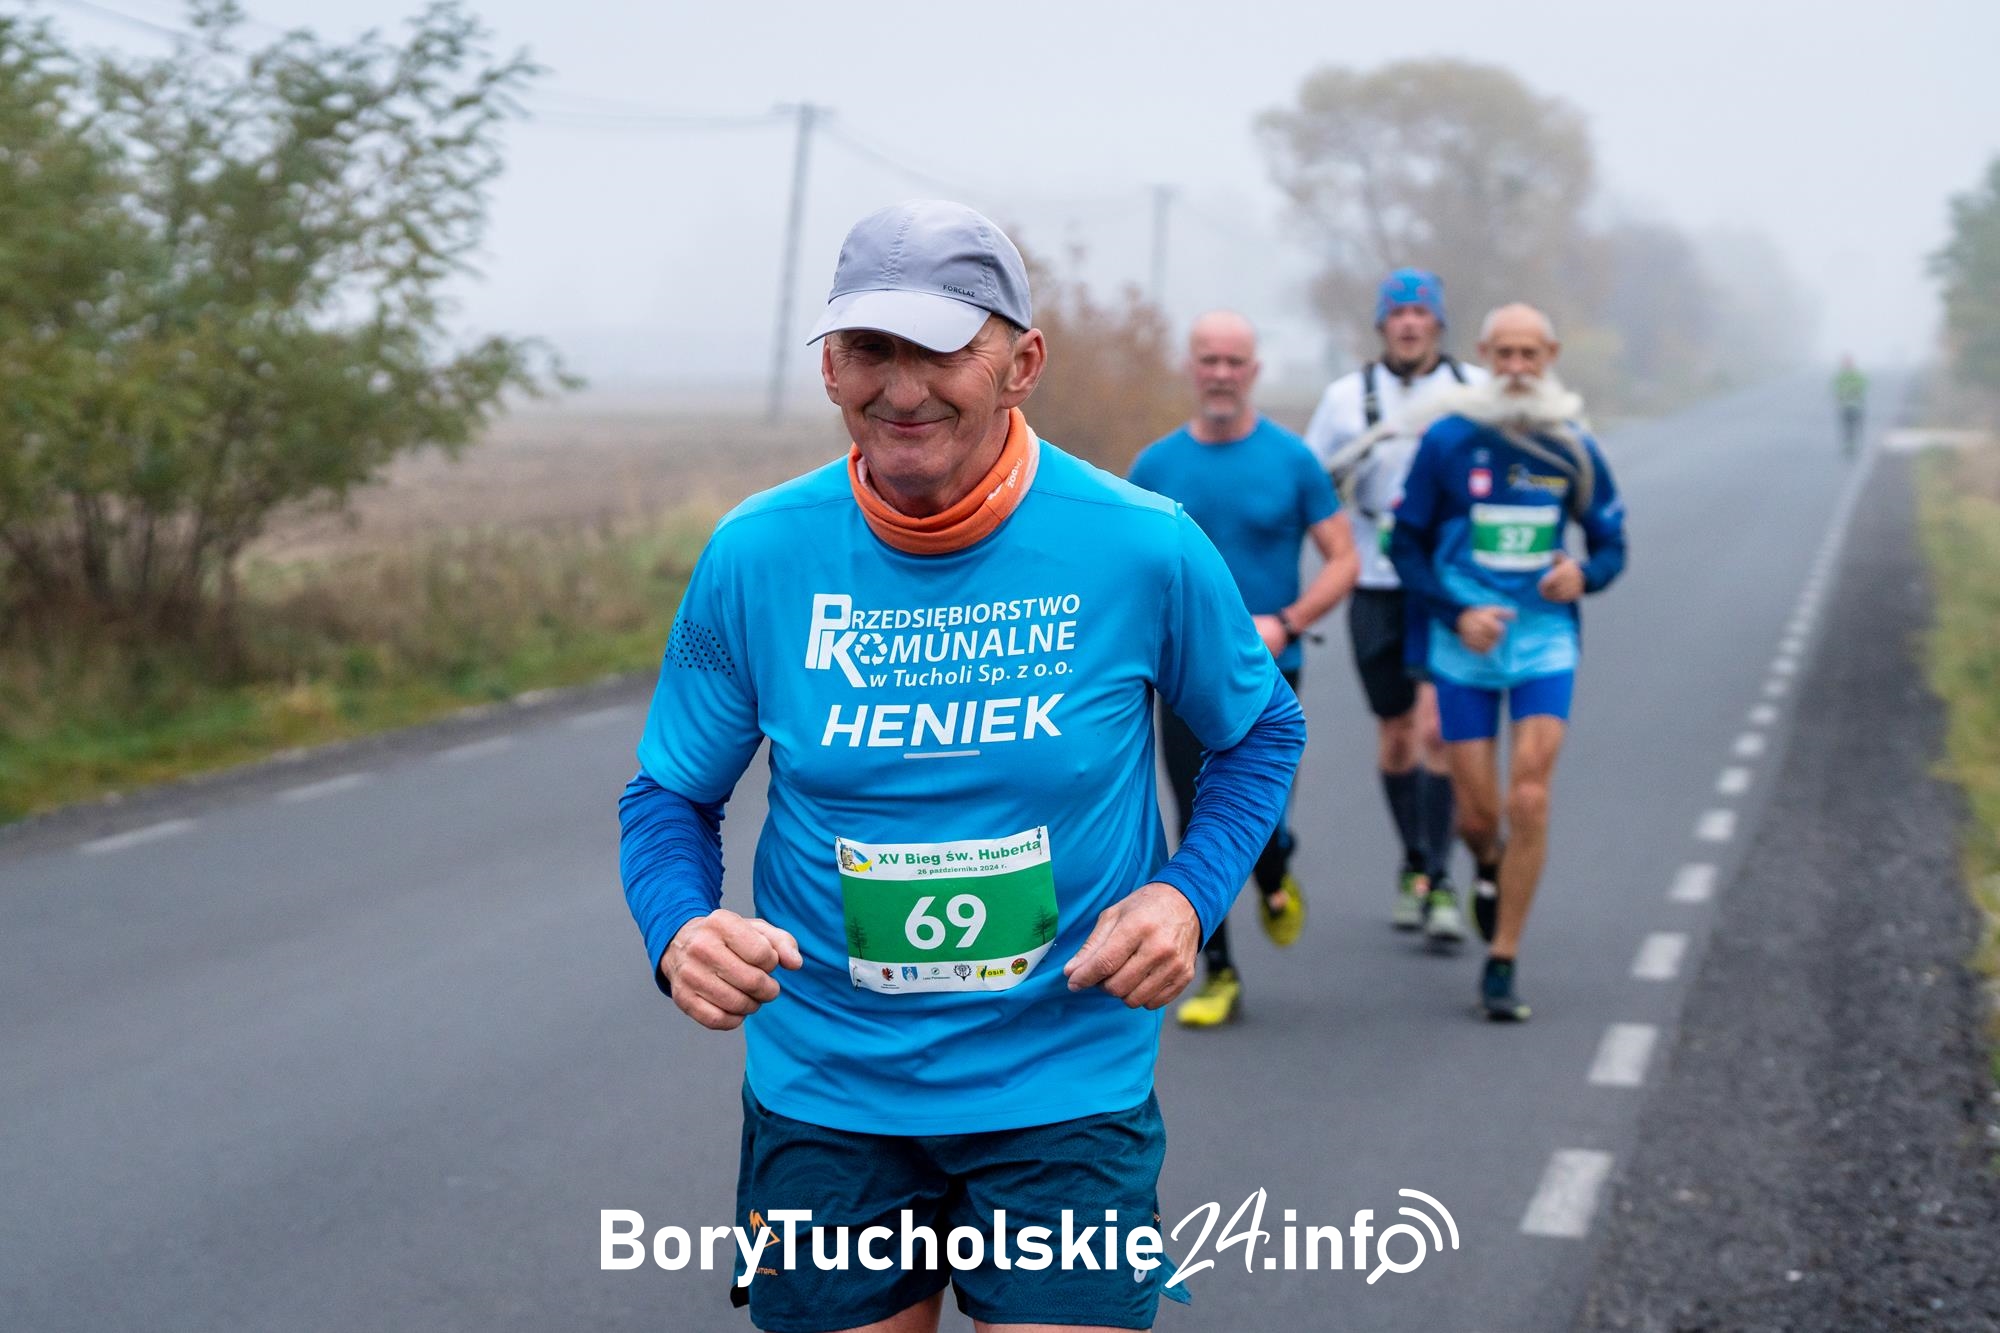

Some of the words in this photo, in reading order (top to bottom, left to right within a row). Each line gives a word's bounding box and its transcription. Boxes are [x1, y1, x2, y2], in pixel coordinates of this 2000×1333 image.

[943, 284, 975, 298] FORCLAZ
[869, 674, 887, 687] w
[893, 665, 973, 687] Tucholi
[978, 664, 1011, 686] Sp.
[1017, 665, 1028, 679] z
[1034, 661, 1073, 677] o.o.
[820, 693, 1065, 747] HENIEK
[878, 853, 900, 865] XV
[905, 852, 941, 866] Bieg
[946, 851, 973, 862] św.
[978, 839, 1041, 860] Huberta
[905, 893, 987, 950] 69
